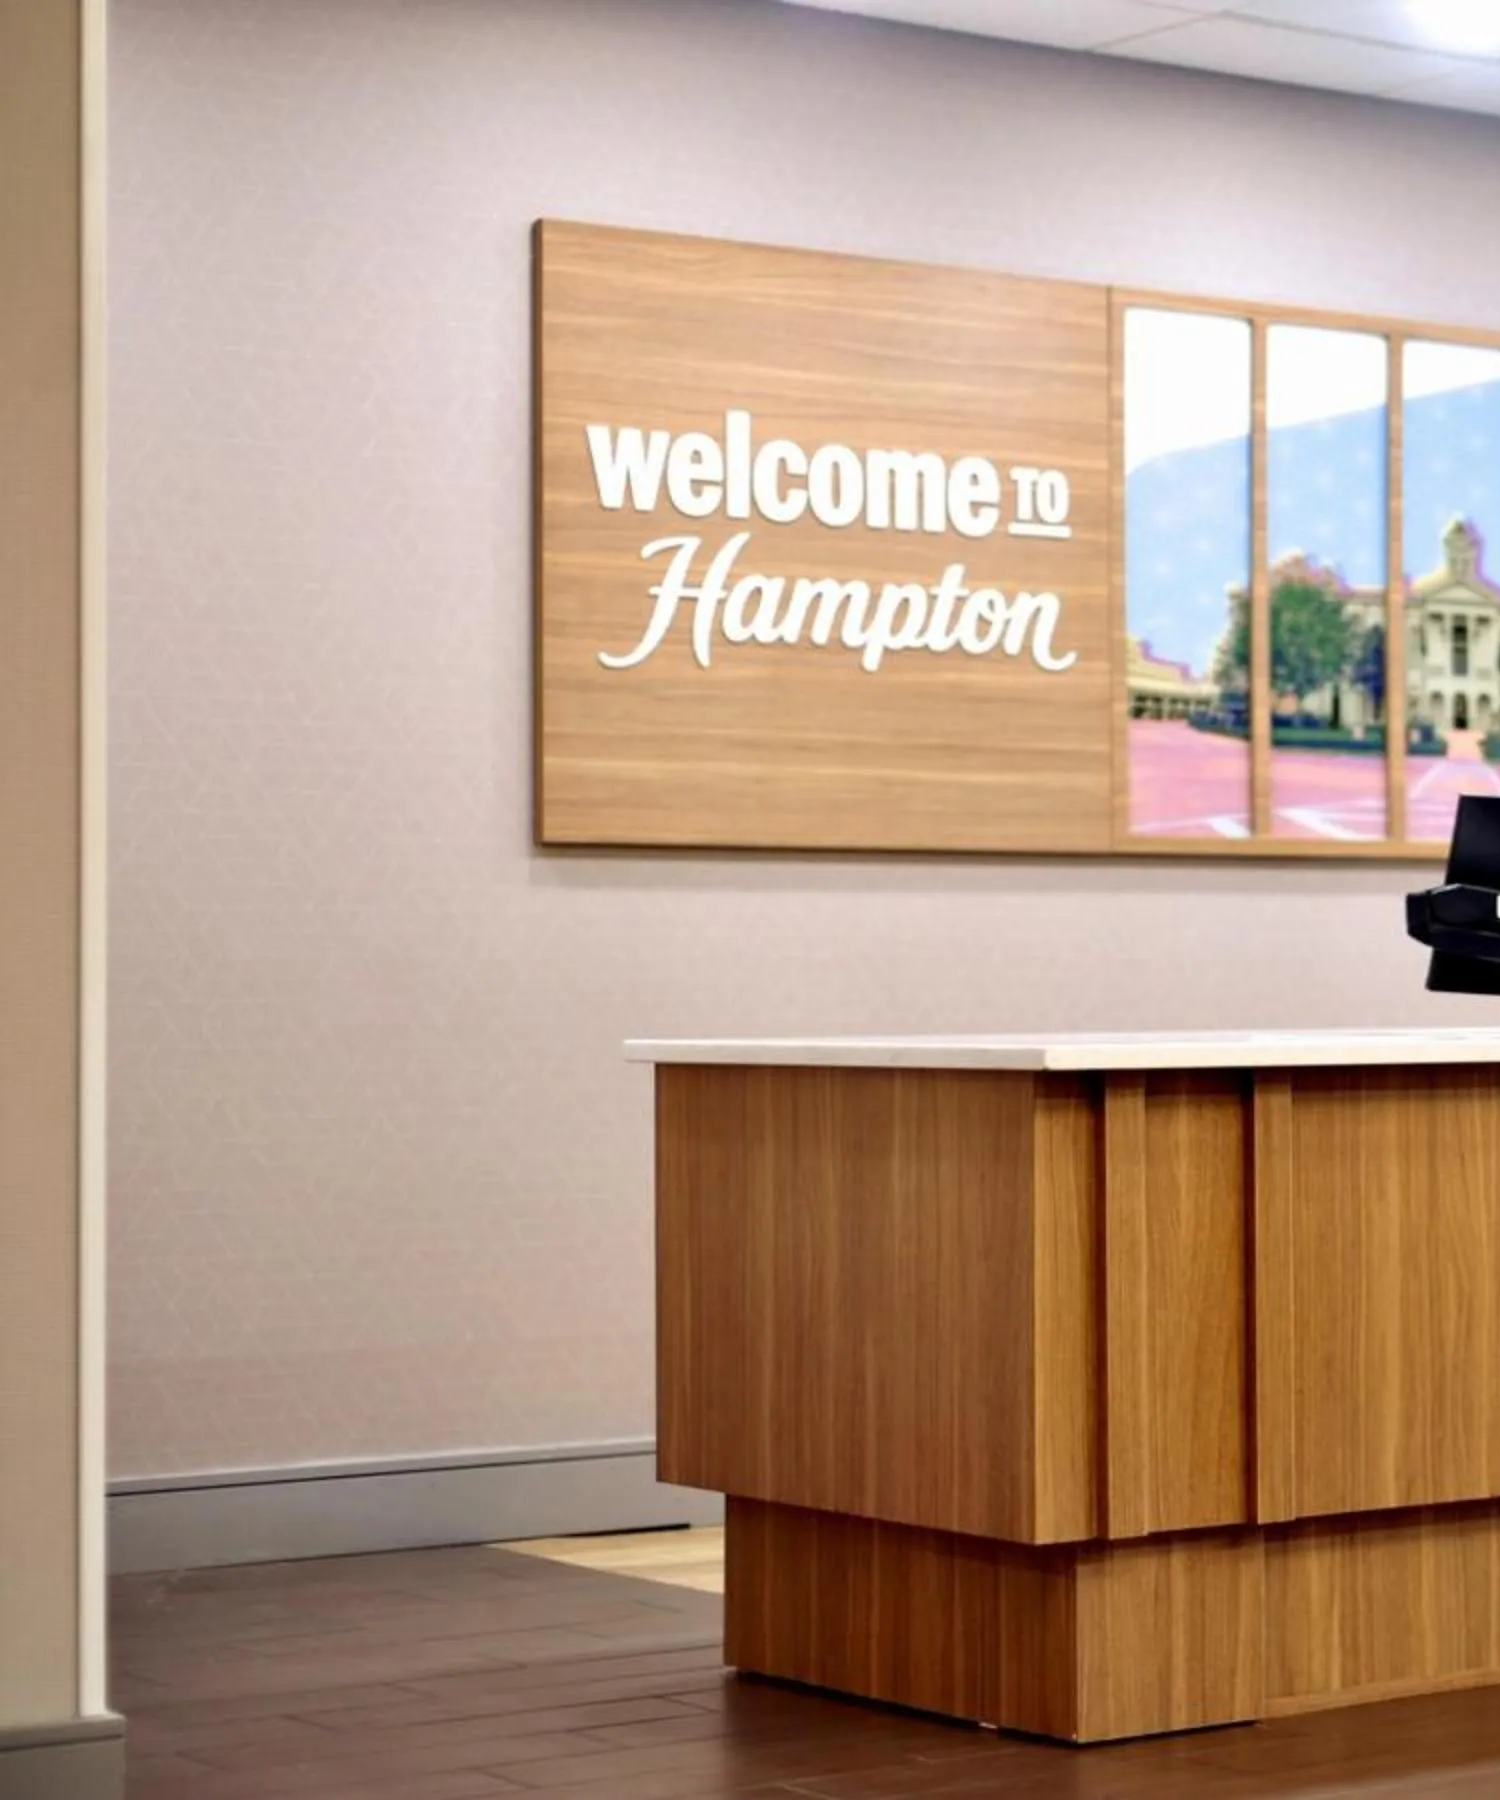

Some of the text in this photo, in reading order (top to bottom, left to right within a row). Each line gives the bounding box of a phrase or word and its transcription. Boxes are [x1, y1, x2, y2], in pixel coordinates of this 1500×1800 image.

[586, 410, 1070, 537] welcome TO
[598, 532, 1077, 671] Hampton
